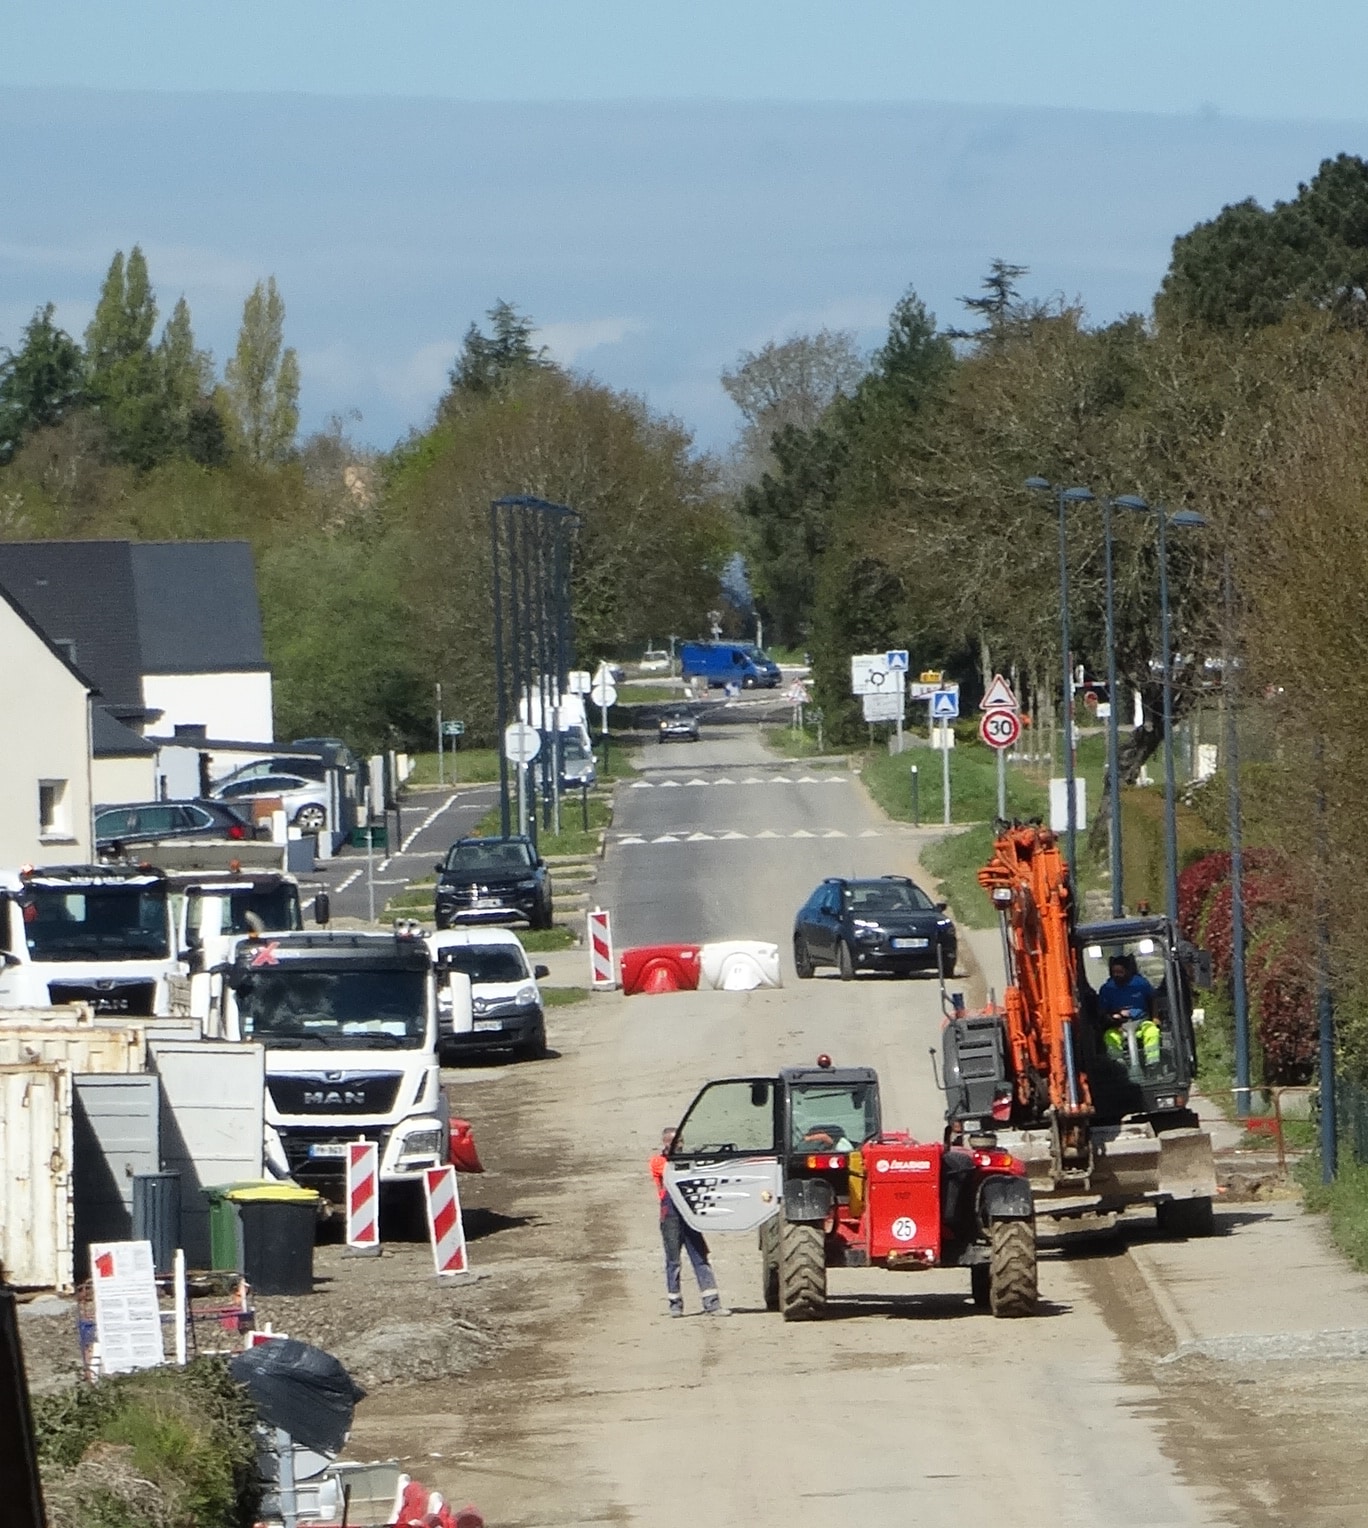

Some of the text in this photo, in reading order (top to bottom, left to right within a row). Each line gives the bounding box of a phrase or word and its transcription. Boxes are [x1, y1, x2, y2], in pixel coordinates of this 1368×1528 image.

[989, 720, 1012, 736] 30
[303, 1090, 366, 1105] MAN
[897, 1220, 912, 1237] 25
